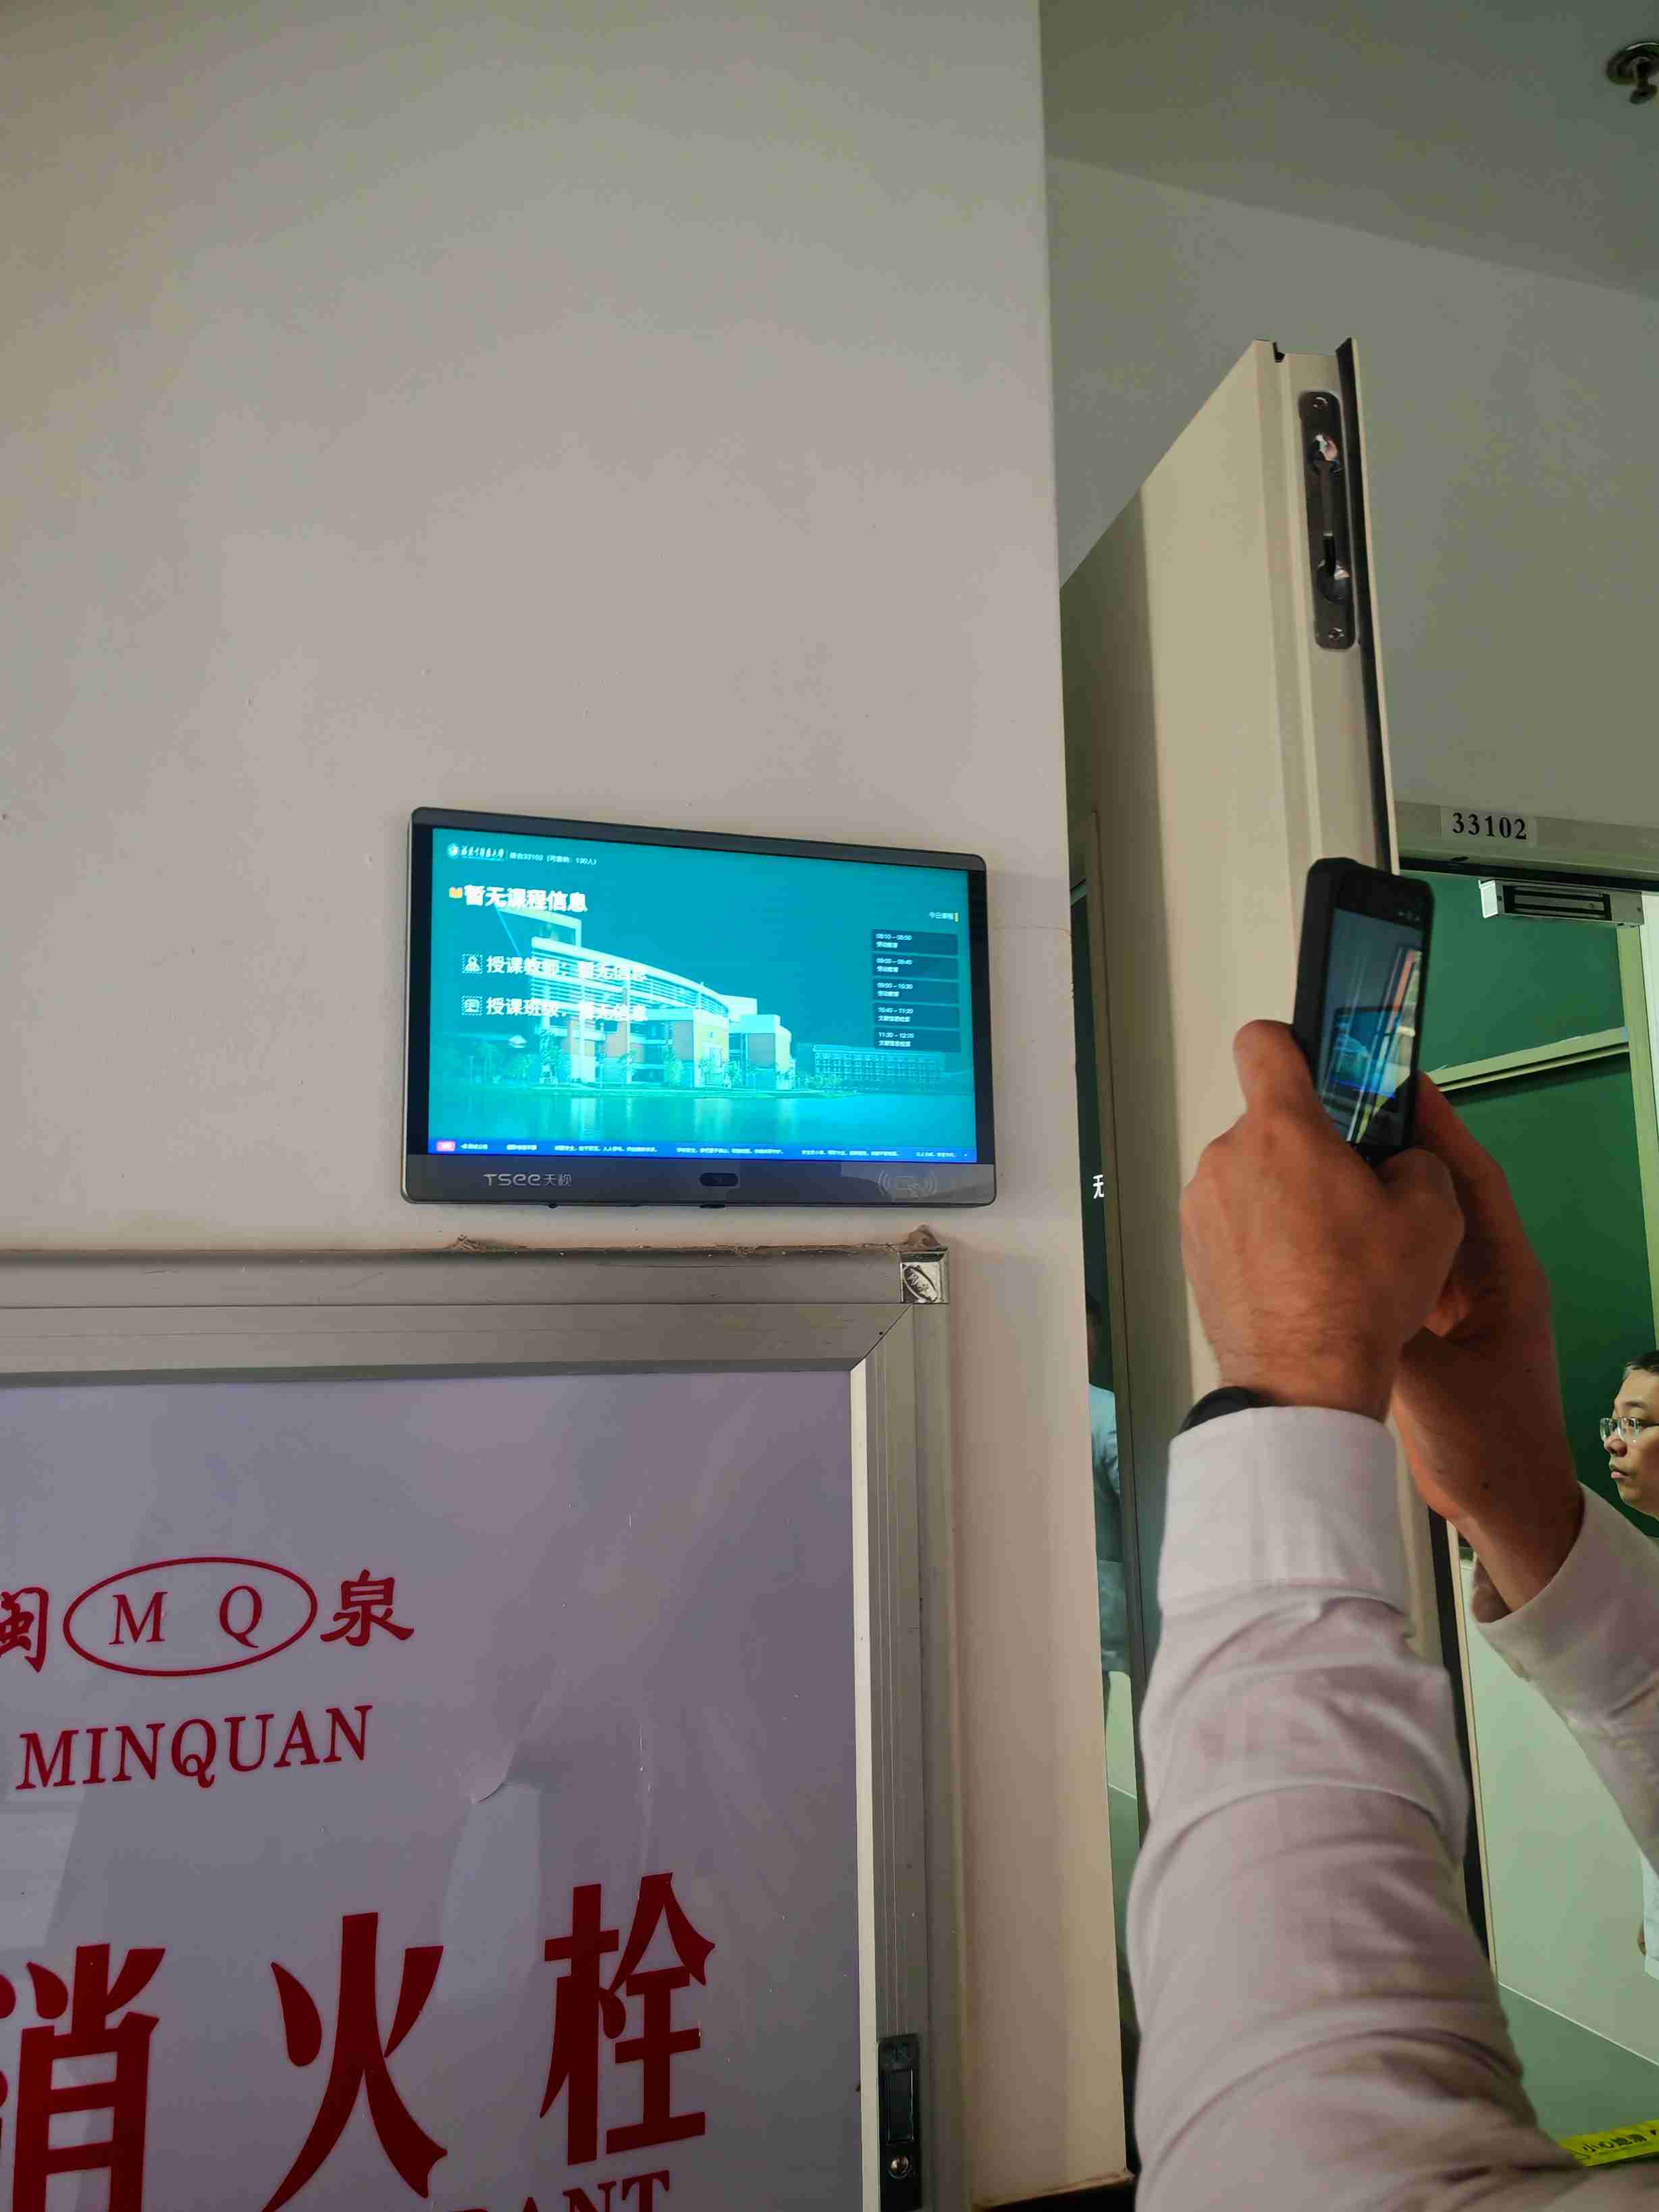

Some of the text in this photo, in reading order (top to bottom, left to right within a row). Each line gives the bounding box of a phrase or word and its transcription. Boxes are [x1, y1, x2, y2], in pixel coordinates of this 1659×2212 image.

[1452, 812, 1527, 840] 33102
[464, 884, 588, 912] 暂无课程信息
[109, 1591, 168, 1645] M
[219, 1585, 263, 1648] Q
[319, 1569, 414, 1647] 泉
[16, 1705, 373, 1789] MINQUAN
